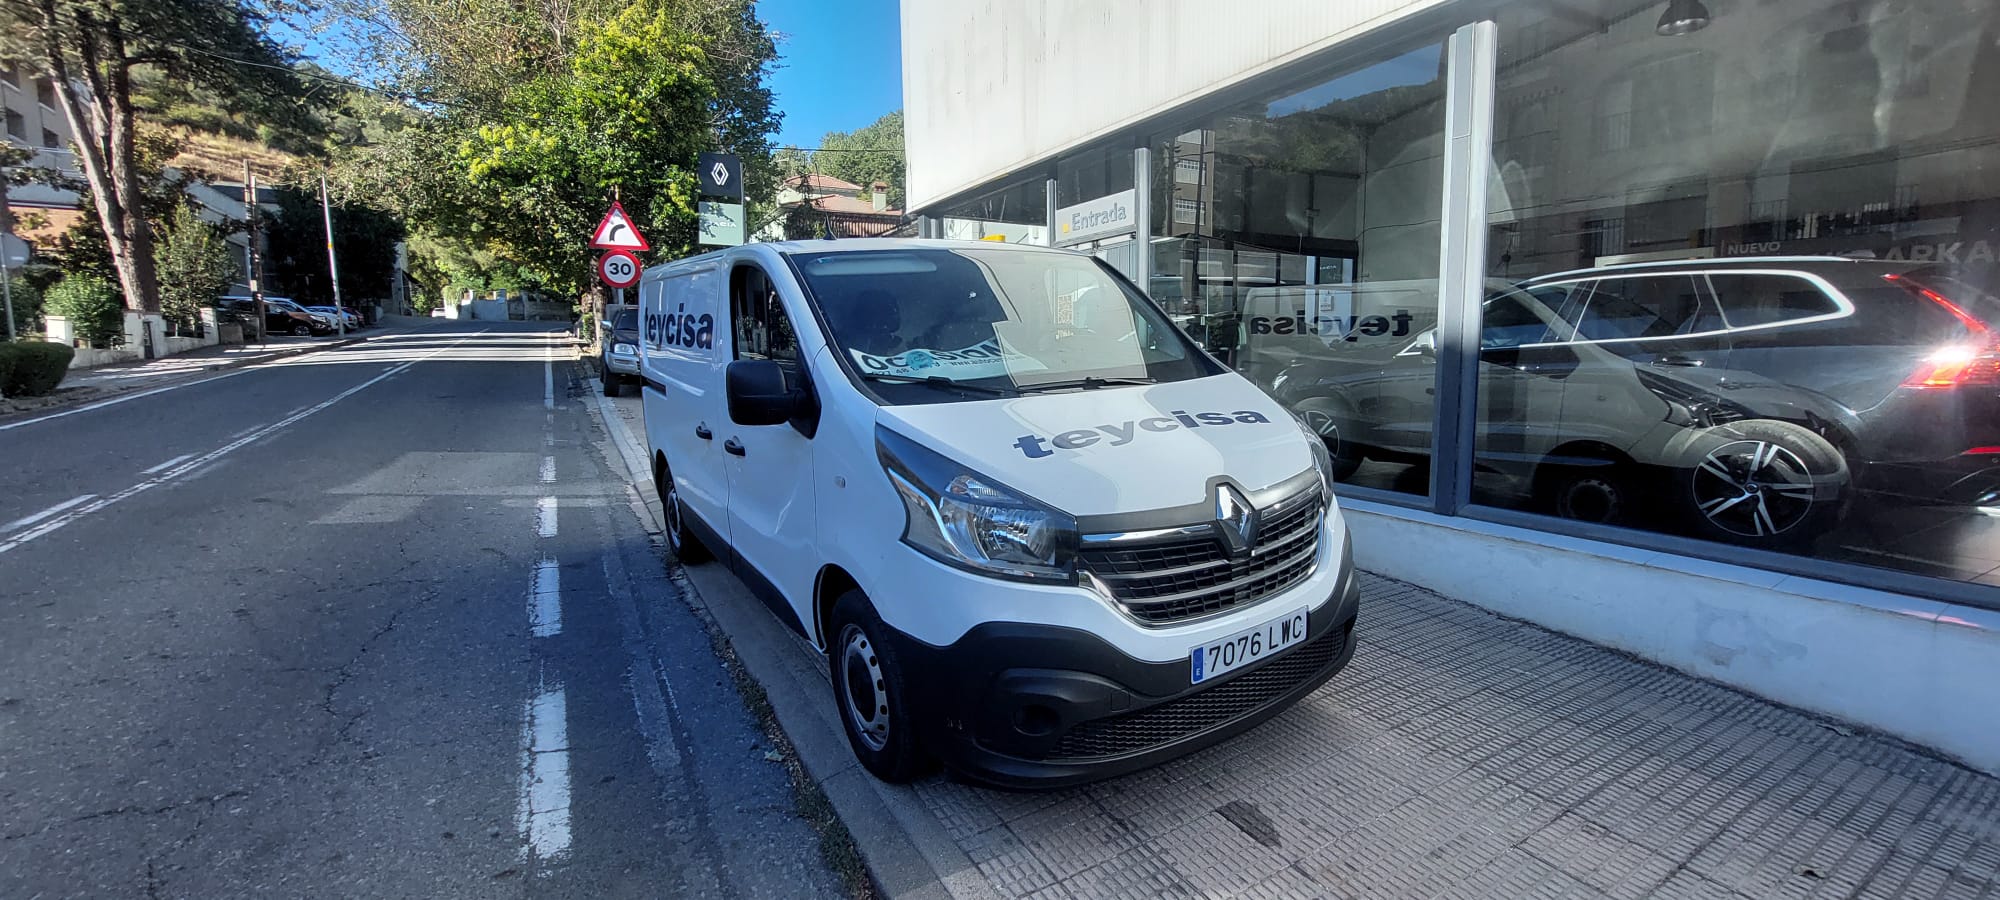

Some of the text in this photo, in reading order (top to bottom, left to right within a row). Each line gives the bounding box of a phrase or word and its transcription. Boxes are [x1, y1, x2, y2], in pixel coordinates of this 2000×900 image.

[1072, 202, 1127, 231] Entrada
[1727, 241, 1782, 255] NUEVO
[1885, 240, 2000, 263] ARKA
[609, 262, 632, 276] 30
[645, 303, 713, 350] teycisa
[1013, 410, 1271, 458] teycisa
[1209, 616, 1302, 672] 7076 LWC
[1196, 667, 1201, 676] E
